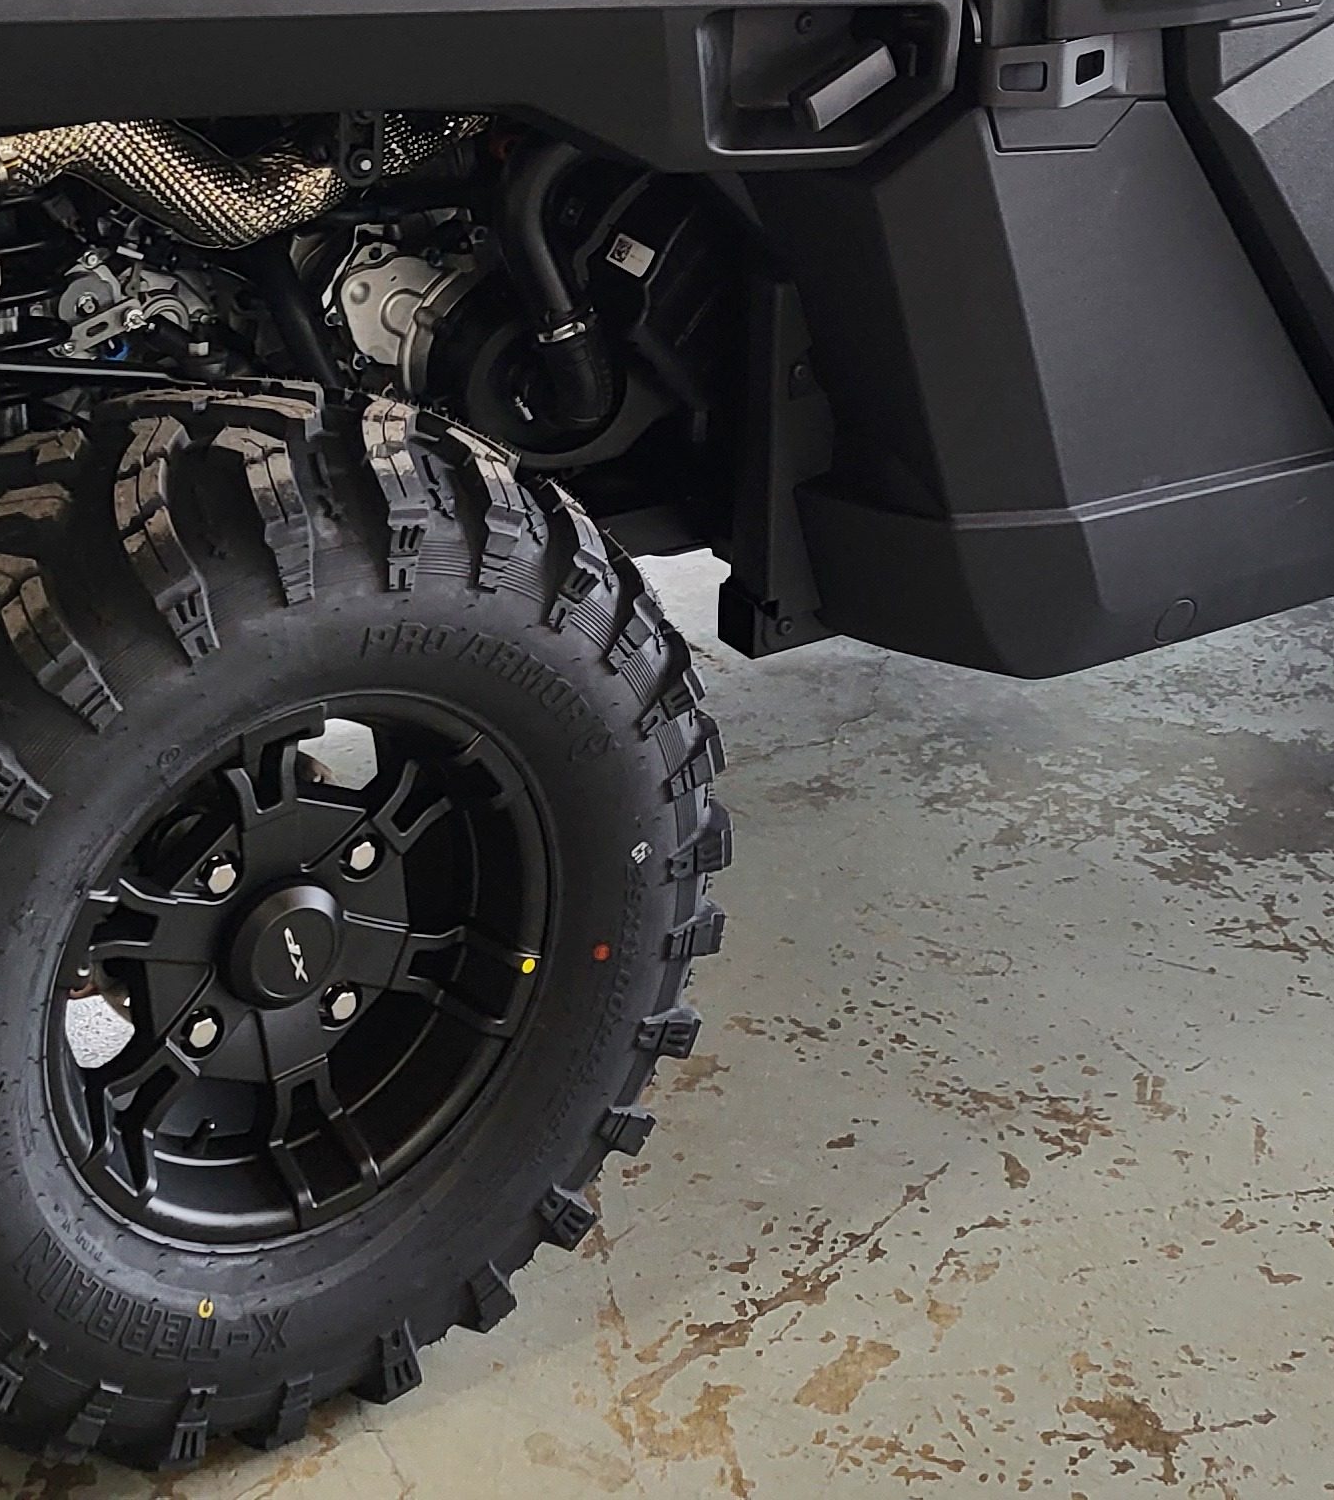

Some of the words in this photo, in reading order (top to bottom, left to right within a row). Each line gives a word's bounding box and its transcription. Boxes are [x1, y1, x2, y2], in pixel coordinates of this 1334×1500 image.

[361, 621, 457, 658] PRO
[456, 631, 592, 724] ARMOR
[283, 926, 309, 983] XP
[14, 1227, 292, 1361] X-TERRAIN
